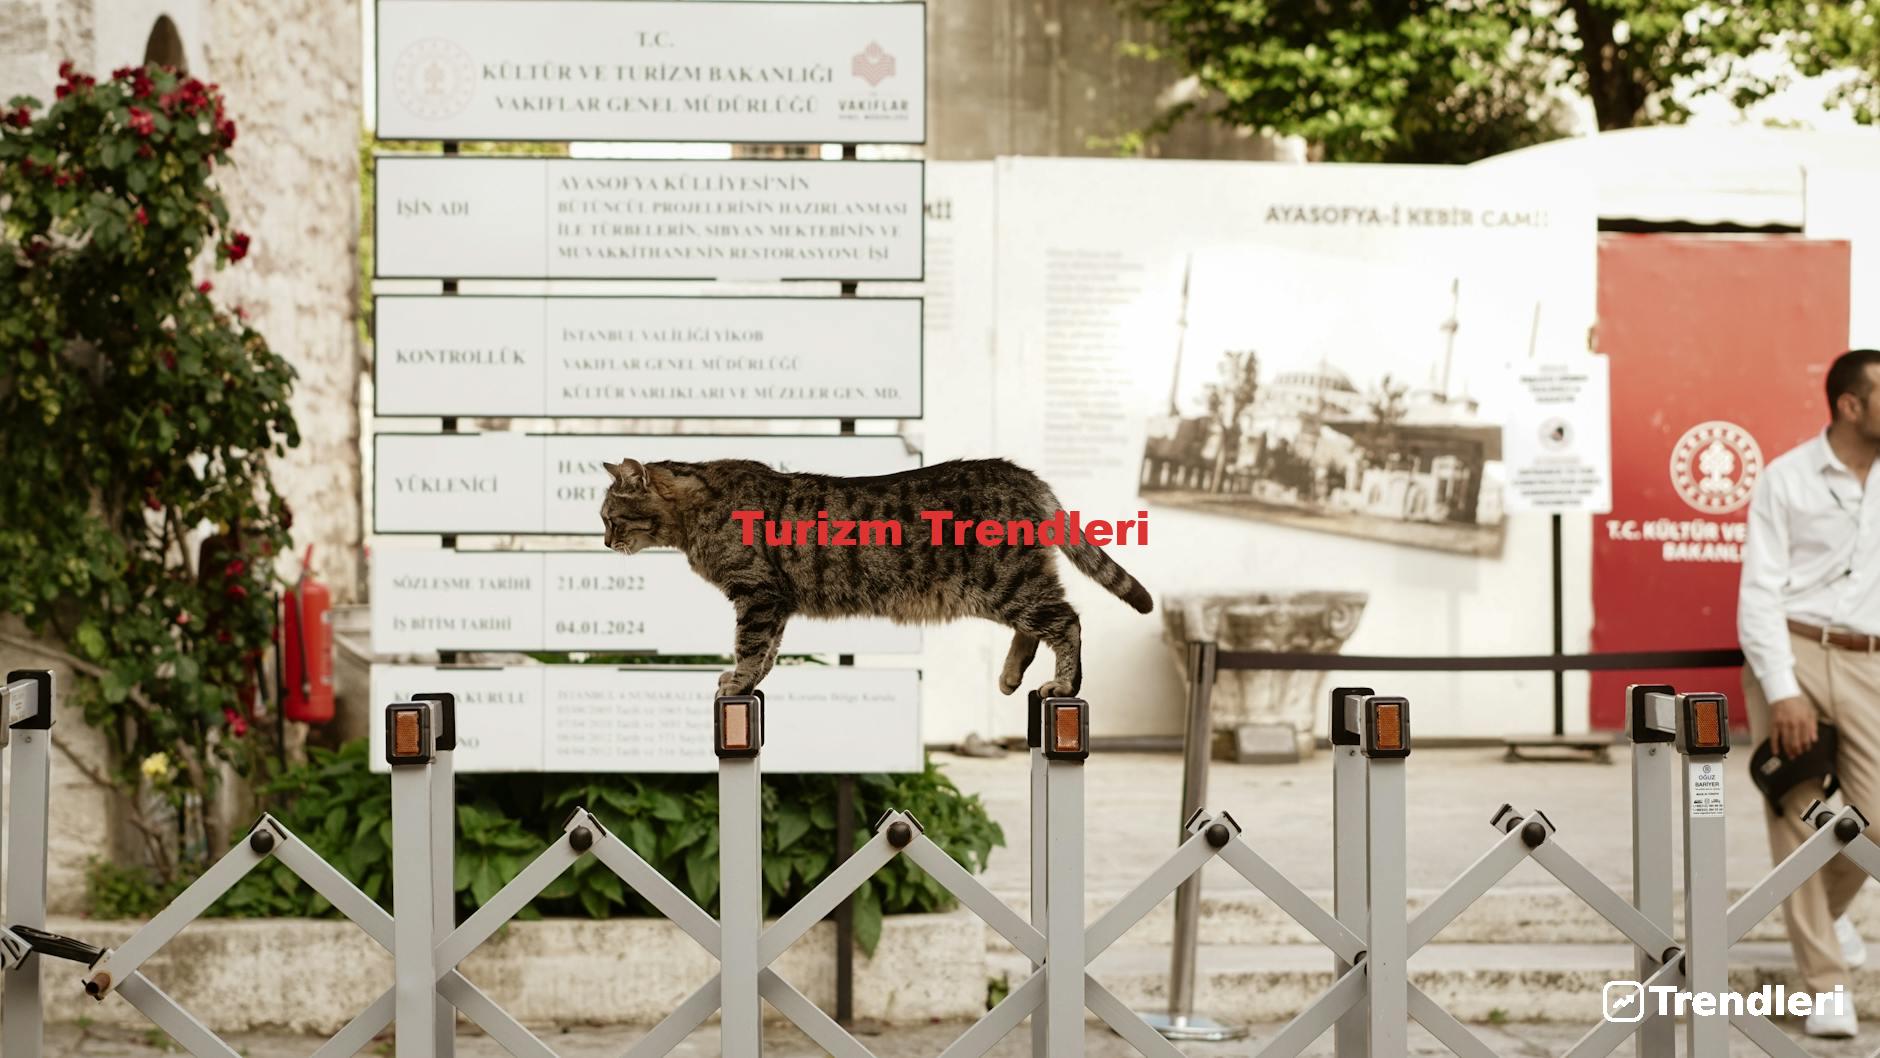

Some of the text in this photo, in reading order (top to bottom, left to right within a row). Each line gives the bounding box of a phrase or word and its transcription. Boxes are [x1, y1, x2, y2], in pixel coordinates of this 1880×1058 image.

[636, 31, 675, 48] T.C.
[482, 59, 833, 84] KÜLTÜR VE TURİZM BAKANLIĞI
[495, 94, 819, 114] VAKIFLAR GENEL MÜDÜRLÜĞÜ
[838, 100, 909, 112] VAKIFLAR
[559, 176, 659, 191] AYASOFYA
[396, 197, 470, 220] İŞİN ADI
[557, 197, 908, 216] BÜTÜNCÜL PROJELERİNİN HAZIRLANMASI
[557, 220, 584, 236] İLE
[769, 222, 876, 238] MEKTEBİNİN
[879, 224, 901, 238] VE
[729, 246, 862, 261] RESTORASYONU
[562, 327, 637, 343] İSTANBUL
[640, 325, 711, 343] VALİLİĞİ
[396, 345, 527, 365] KONTROLLÜK
[562, 354, 801, 372] VAKIFLAR GENEL MÜDÜRLÜĞÜ
[562, 383, 625, 399] KÜLTÜR
[628, 386, 725, 400] VARLIKLARI
[728, 386, 748, 400] VE
[754, 384, 830, 400] MÜZELER
[394, 474, 498, 494] YÜKLENİCİ
[1605, 519, 1641, 541] T.C.
[1643, 517, 1719, 542] KÜLTÜR
[392, 574, 532, 594] SÖZLEŞME TARİHİ
[411, 615, 456, 632] BİTİM
[461, 616, 512, 632] TARİHİ
[555, 619, 646, 636] 04.01.2024
